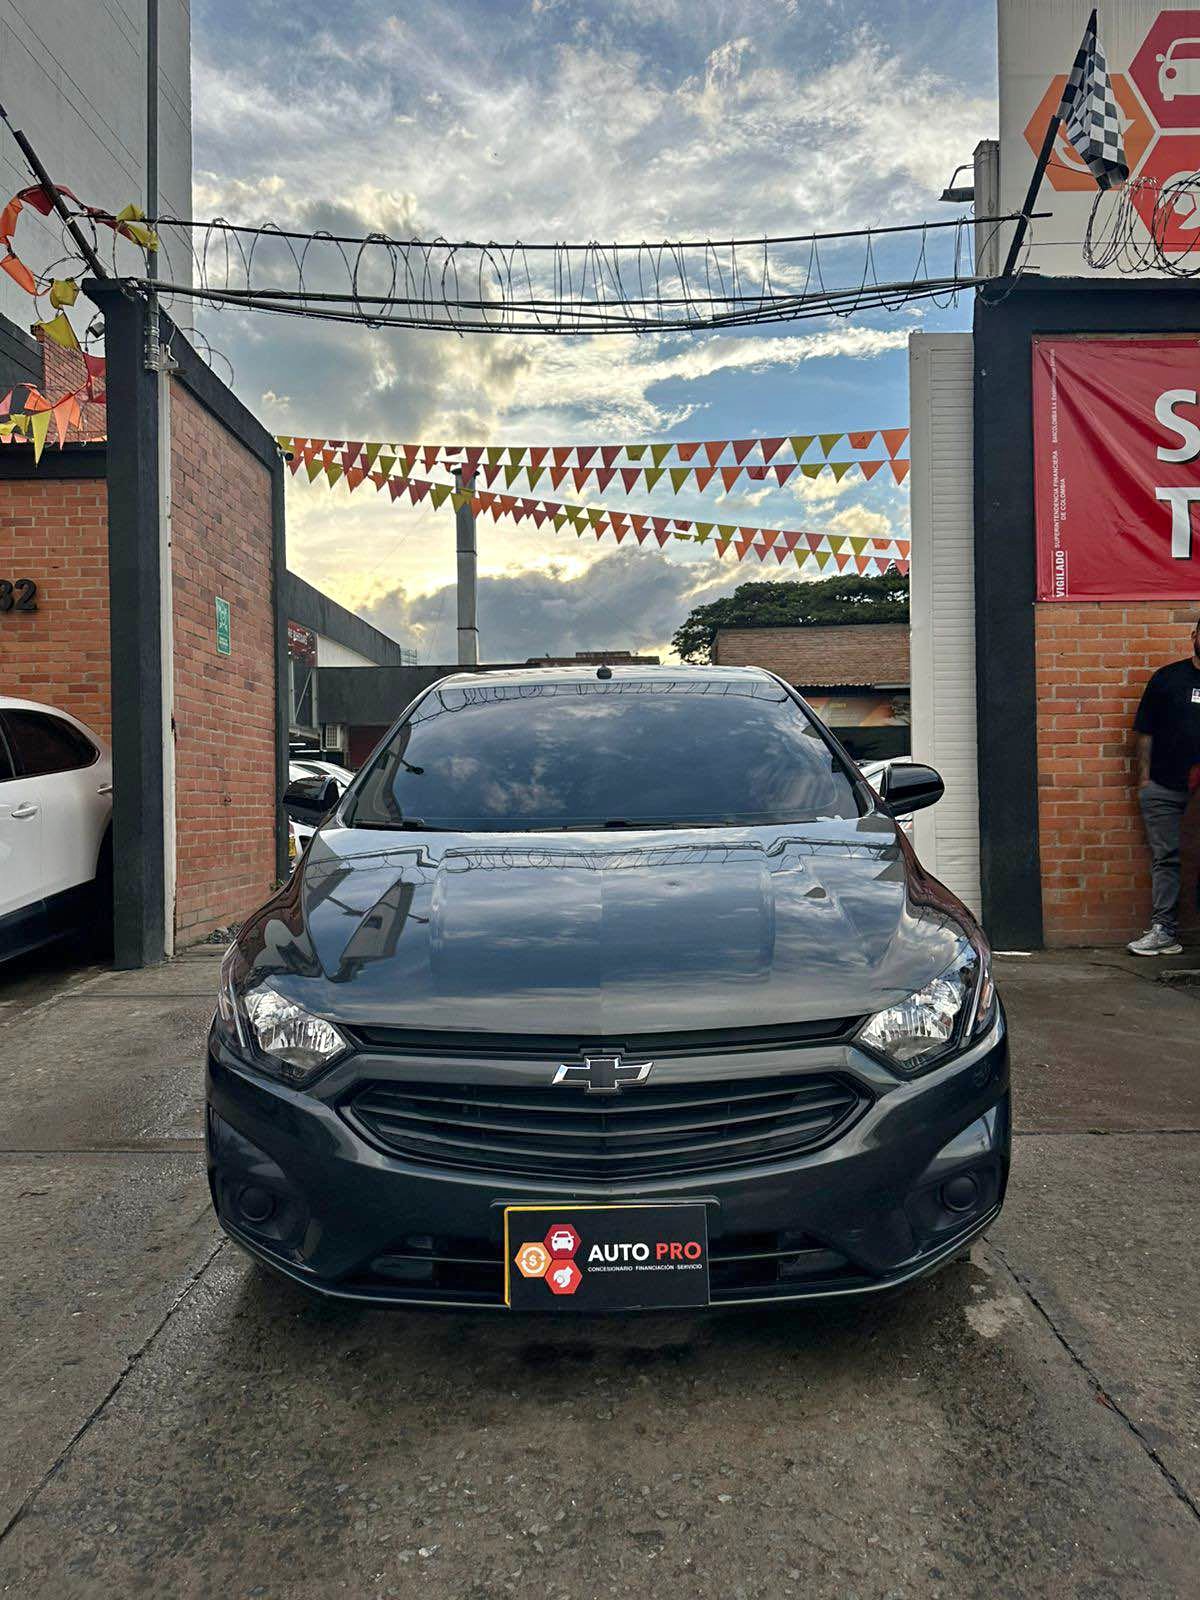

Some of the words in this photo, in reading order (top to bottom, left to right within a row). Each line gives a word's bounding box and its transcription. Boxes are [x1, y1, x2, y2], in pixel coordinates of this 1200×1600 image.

[1061, 511, 1066, 520] DE
[1055, 550, 1065, 598] VIGILADO
[588, 1243, 650, 1262] AUTO
[655, 1242, 702, 1260] PRO
